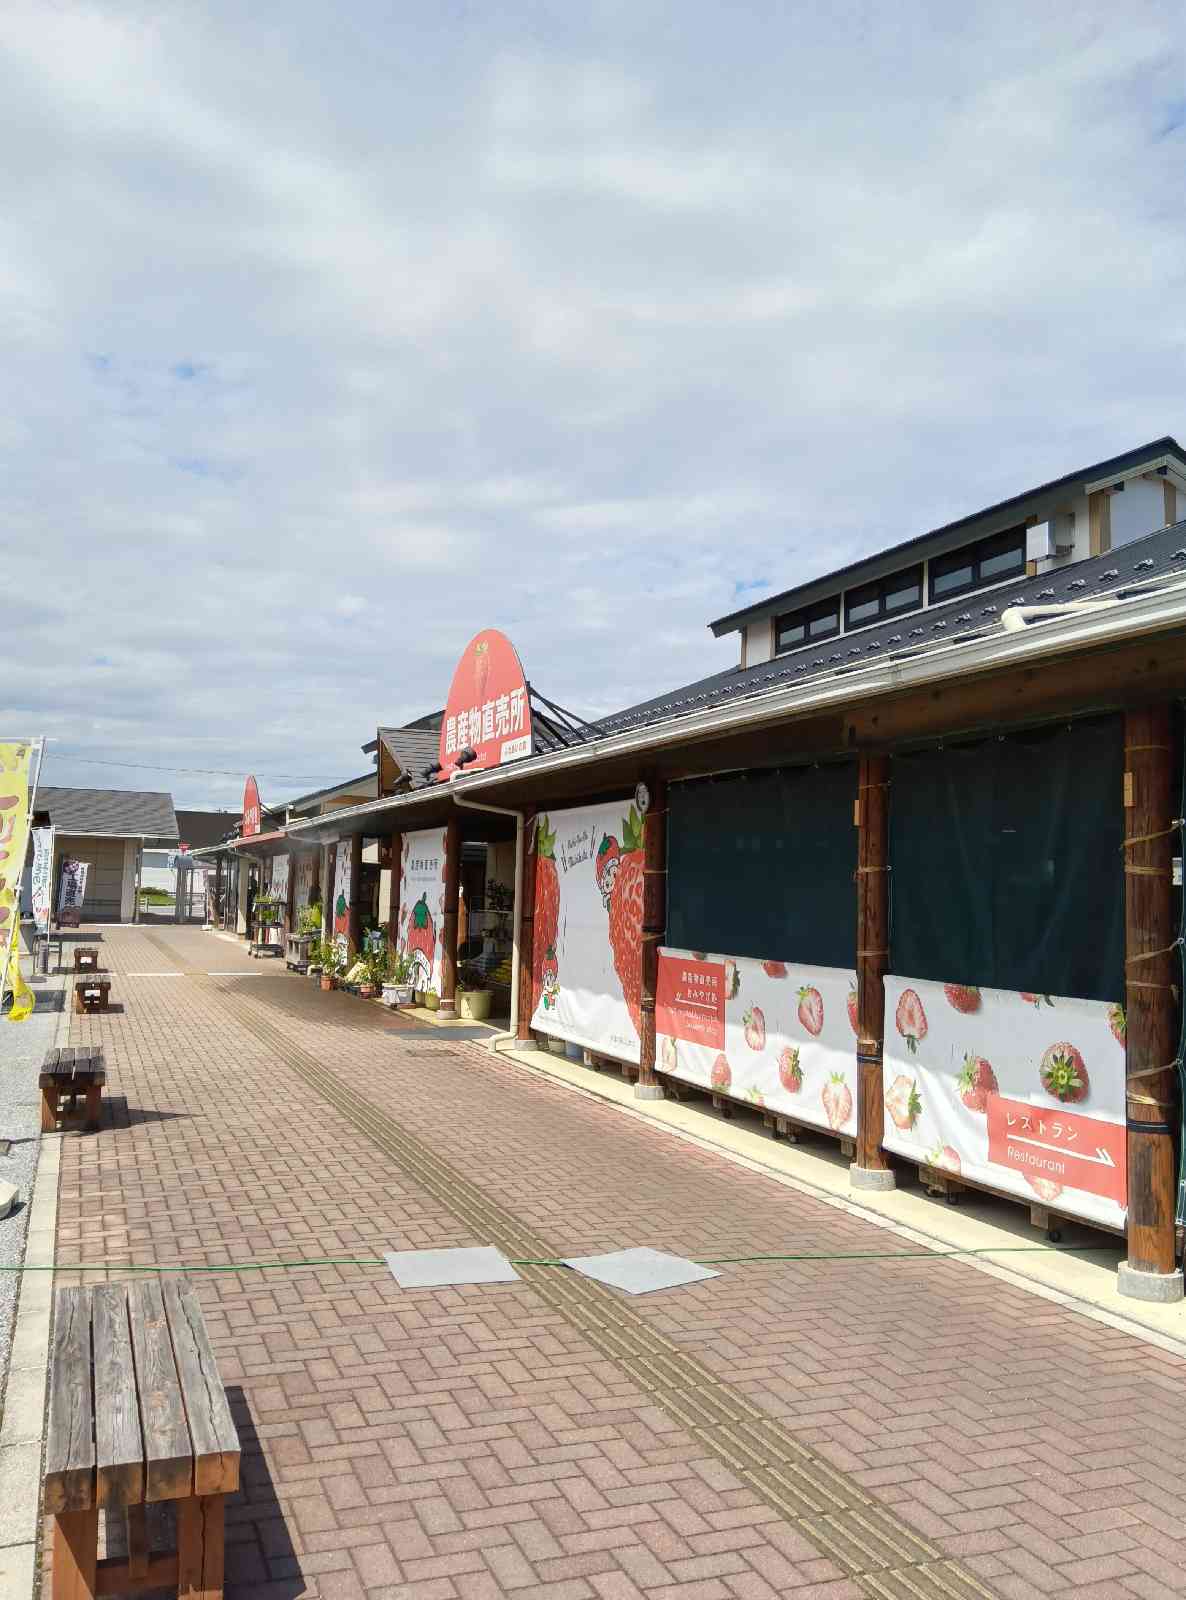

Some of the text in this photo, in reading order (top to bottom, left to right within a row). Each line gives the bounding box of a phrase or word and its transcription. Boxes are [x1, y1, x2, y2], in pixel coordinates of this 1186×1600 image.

[445, 685, 527, 756] 農産物直売所
[1006, 1112, 1079, 1141] レストラン
[1007, 1145, 1065, 1175] Restaurant
